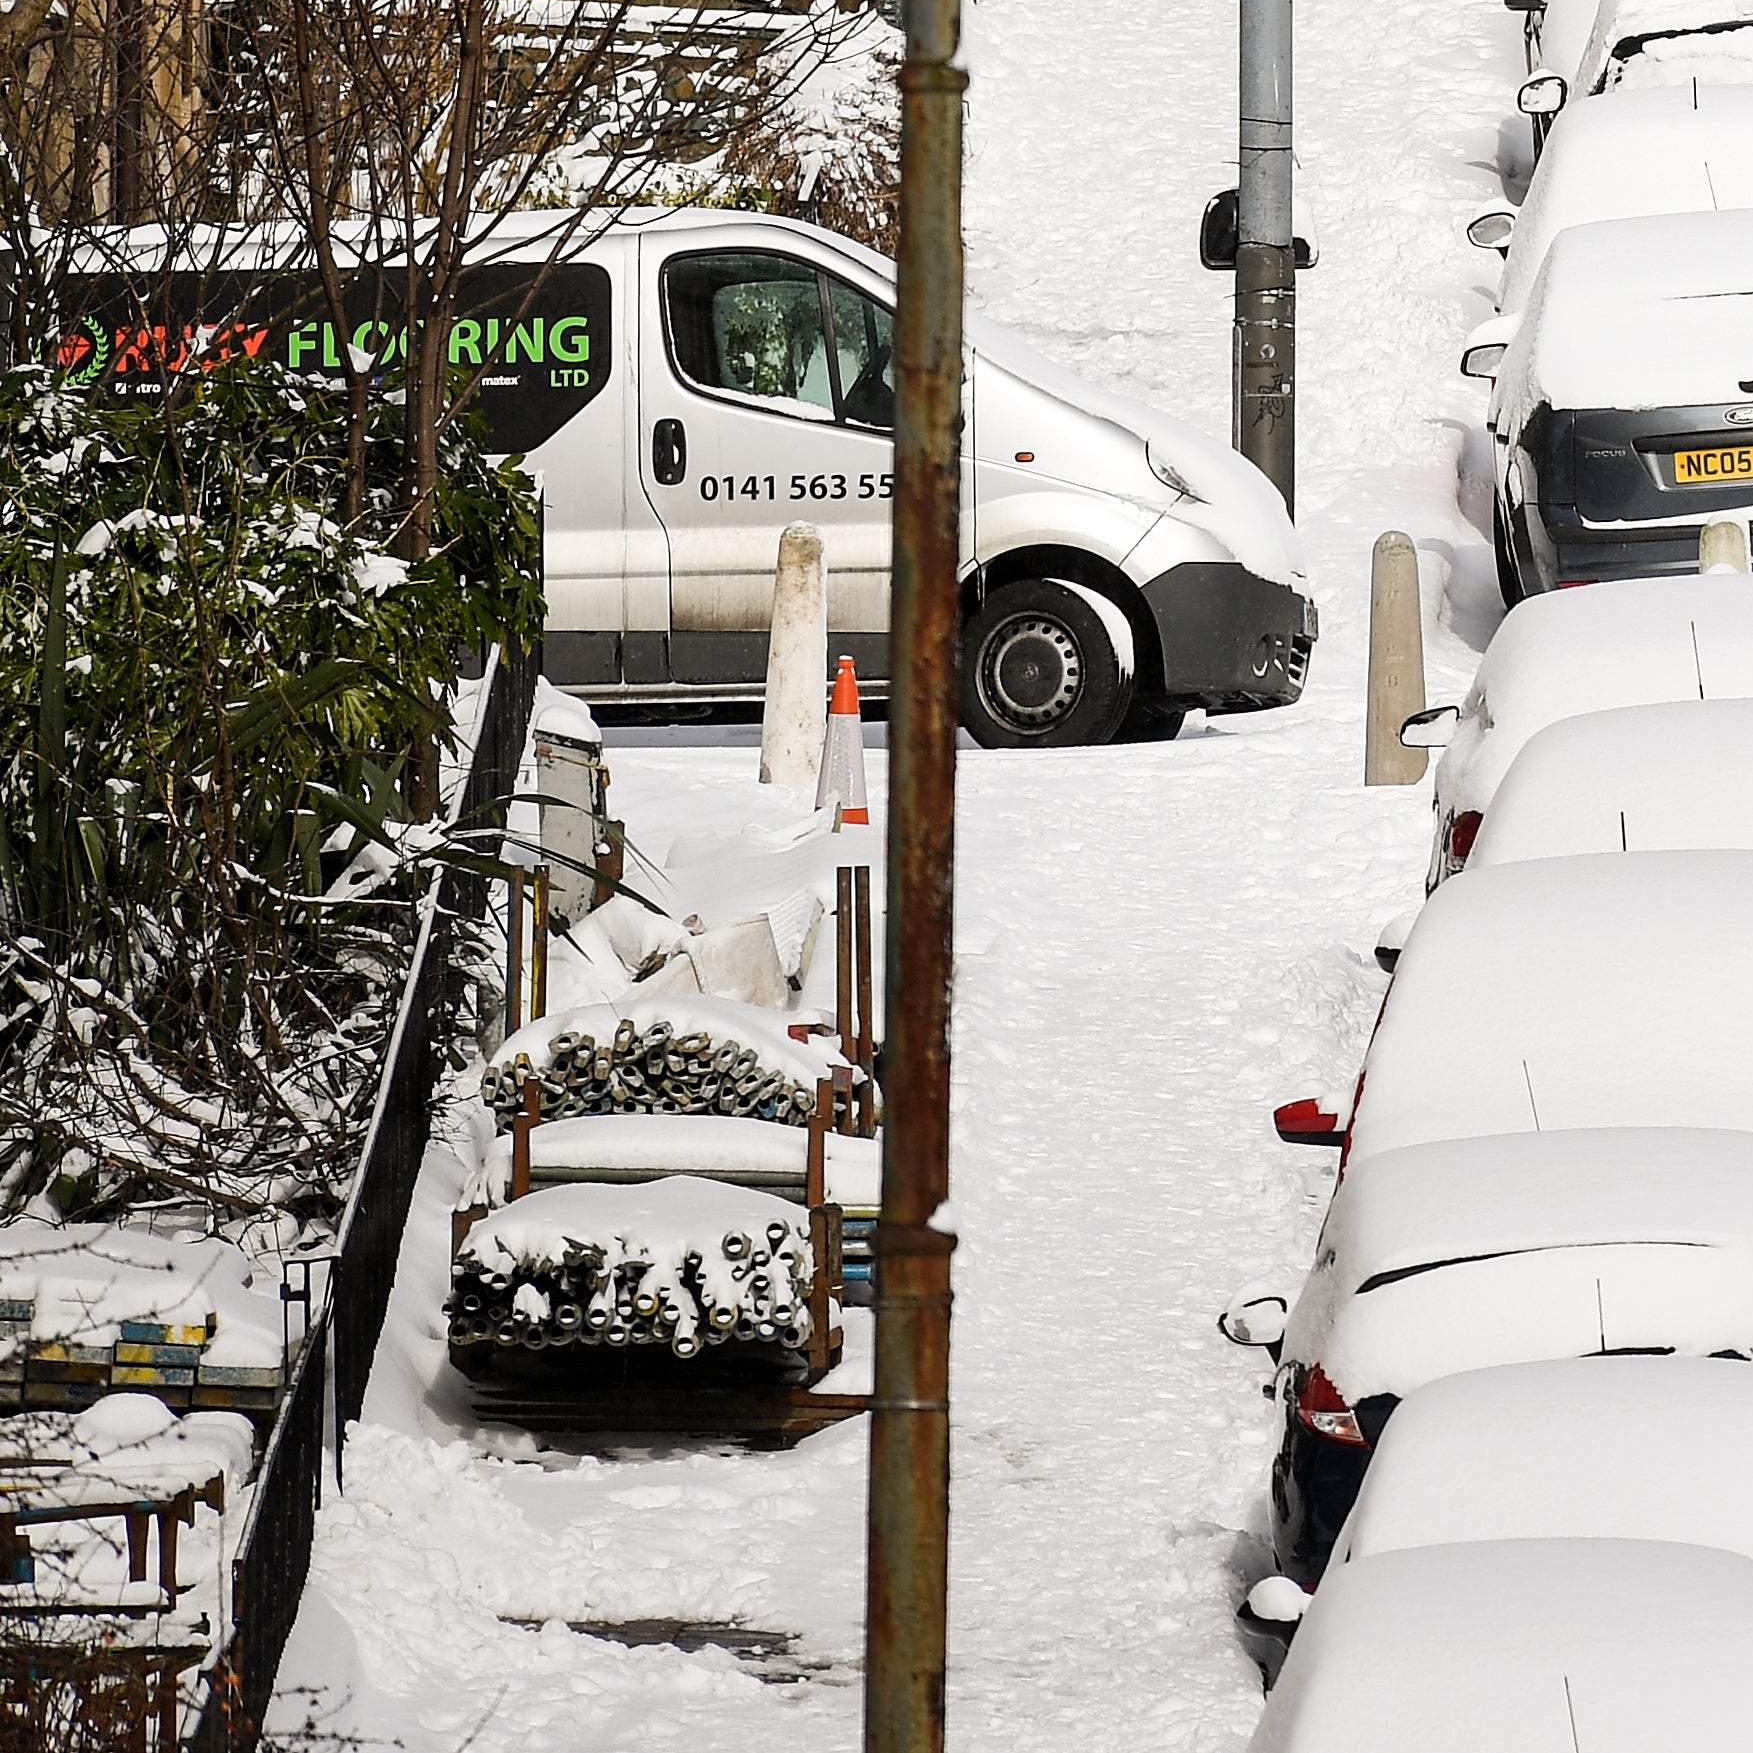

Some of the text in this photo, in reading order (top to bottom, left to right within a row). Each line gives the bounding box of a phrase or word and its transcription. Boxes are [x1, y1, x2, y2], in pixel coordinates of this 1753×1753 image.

[288, 316, 590, 369] FLORING
[550, 369, 590, 388] LTD
[1686, 450, 1752, 477] NC05
[699, 473, 894, 501] 0141 563 55
